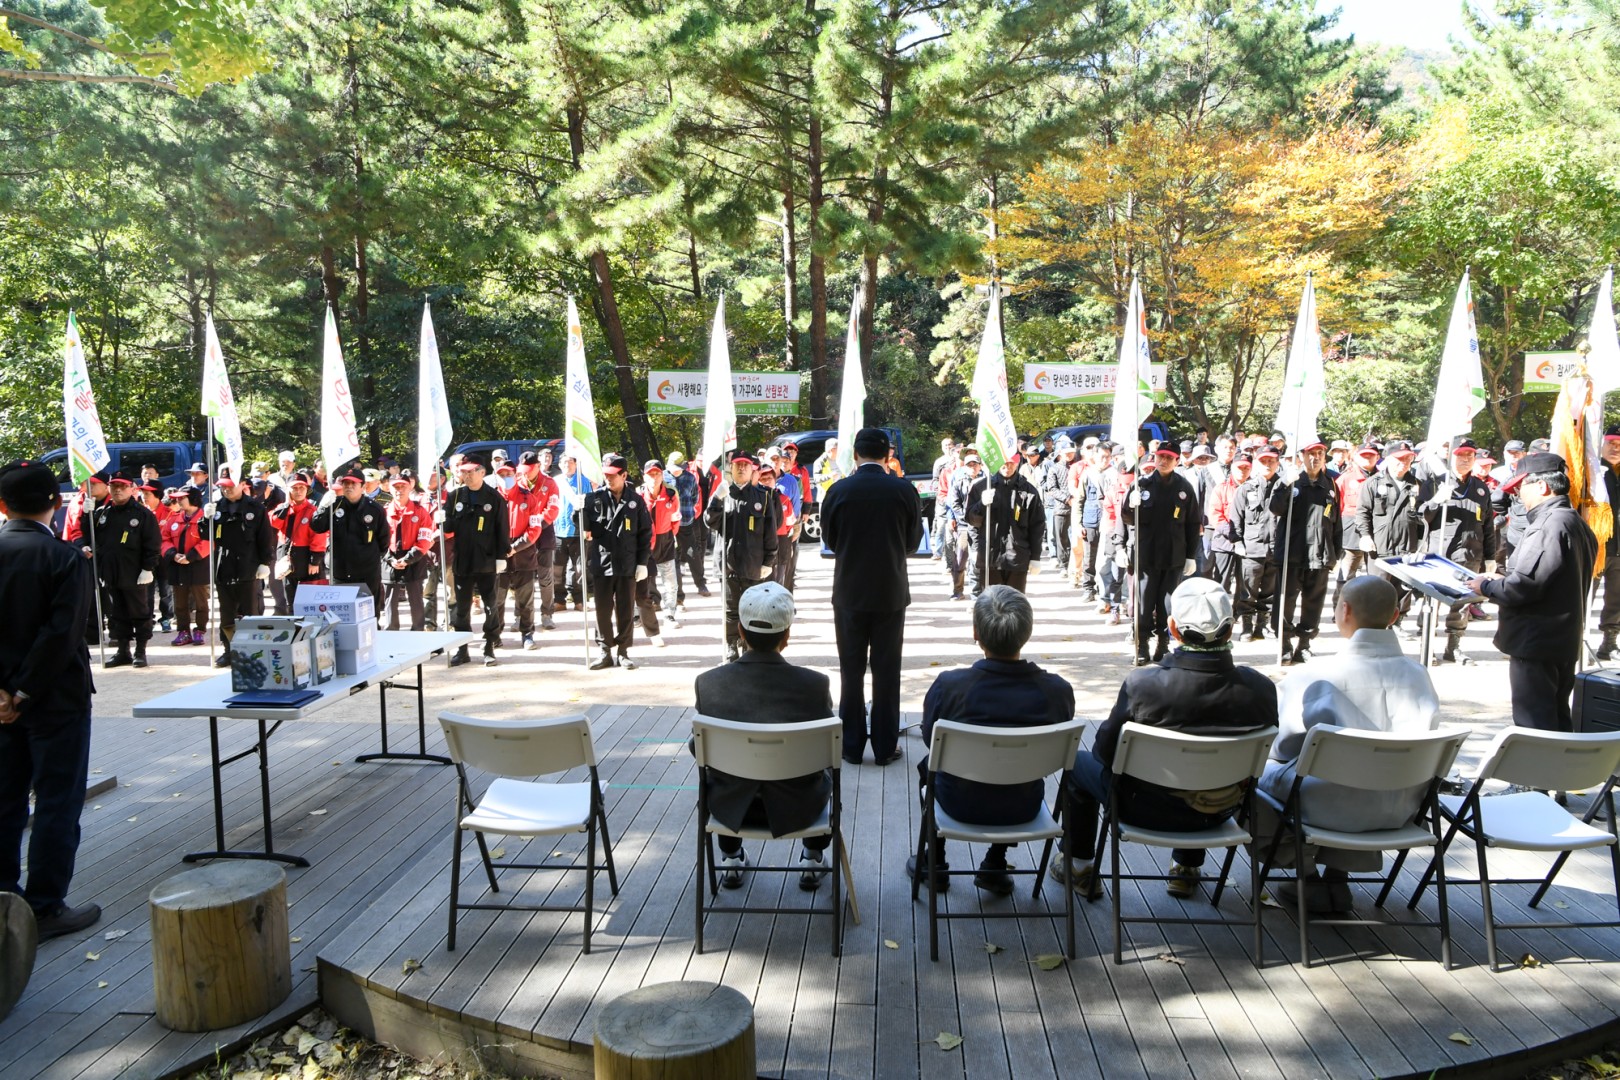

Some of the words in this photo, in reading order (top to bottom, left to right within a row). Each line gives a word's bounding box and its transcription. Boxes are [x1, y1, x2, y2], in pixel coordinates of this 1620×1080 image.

[1053, 374, 1070, 387] 당신의
[1072, 374, 1083, 387] 작은
[1085, 374, 1102, 387] 관심이
[678, 383, 702, 398] 사랑해요
[739, 383, 763, 398] 가꾸어요
[765, 384, 789, 399] 산림보전
